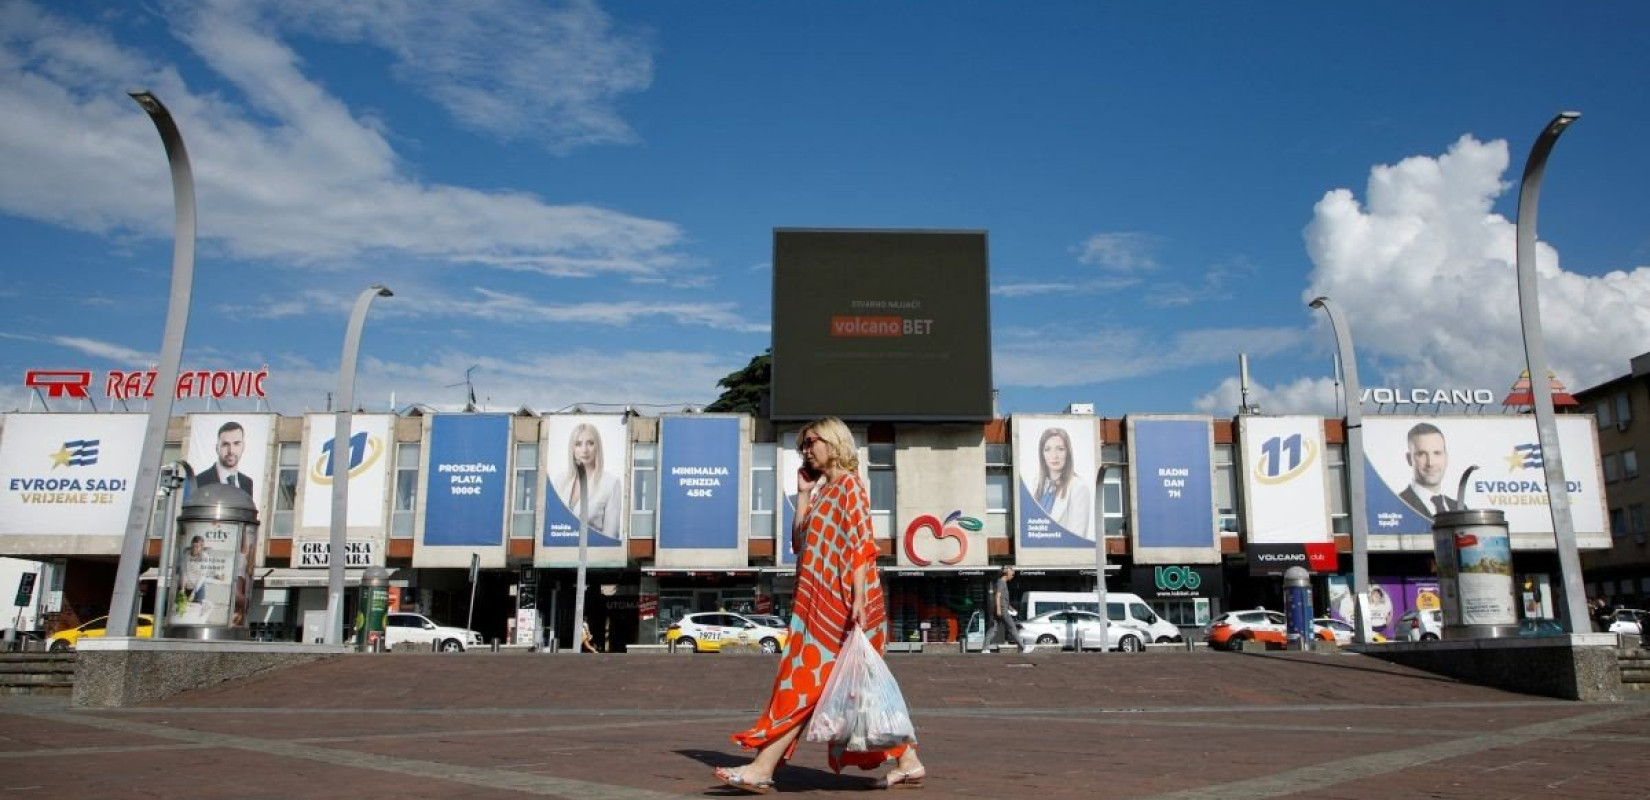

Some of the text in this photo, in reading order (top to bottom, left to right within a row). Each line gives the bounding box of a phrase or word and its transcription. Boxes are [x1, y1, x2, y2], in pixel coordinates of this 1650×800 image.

[903, 319, 934, 335] BET
[106, 364, 268, 398] RAŽATOVIĆ
[1262, 433, 1302, 477] 11
[438, 462, 497, 473] PROSJEČNA
[671, 467, 729, 475] MINIMALNA
[1158, 468, 1189, 477] RADNI
[450, 475, 483, 483] PLATA
[680, 478, 721, 486] PENZIJA
[1163, 479, 1185, 488] DAN
[10, 478, 127, 491] EVROPA SAD!
[1475, 481, 1542, 493] EVROPA
[451, 486, 482, 495] 1000€
[686, 489, 713, 497] 450€
[21, 493, 114, 504] VRIJEME JE!
[1487, 494, 1549, 505] VRIJEME
[303, 543, 370, 553] GRASKA
[302, 554, 370, 565] KNJARA
[1257, 553, 1325, 561] VOLCANO club
